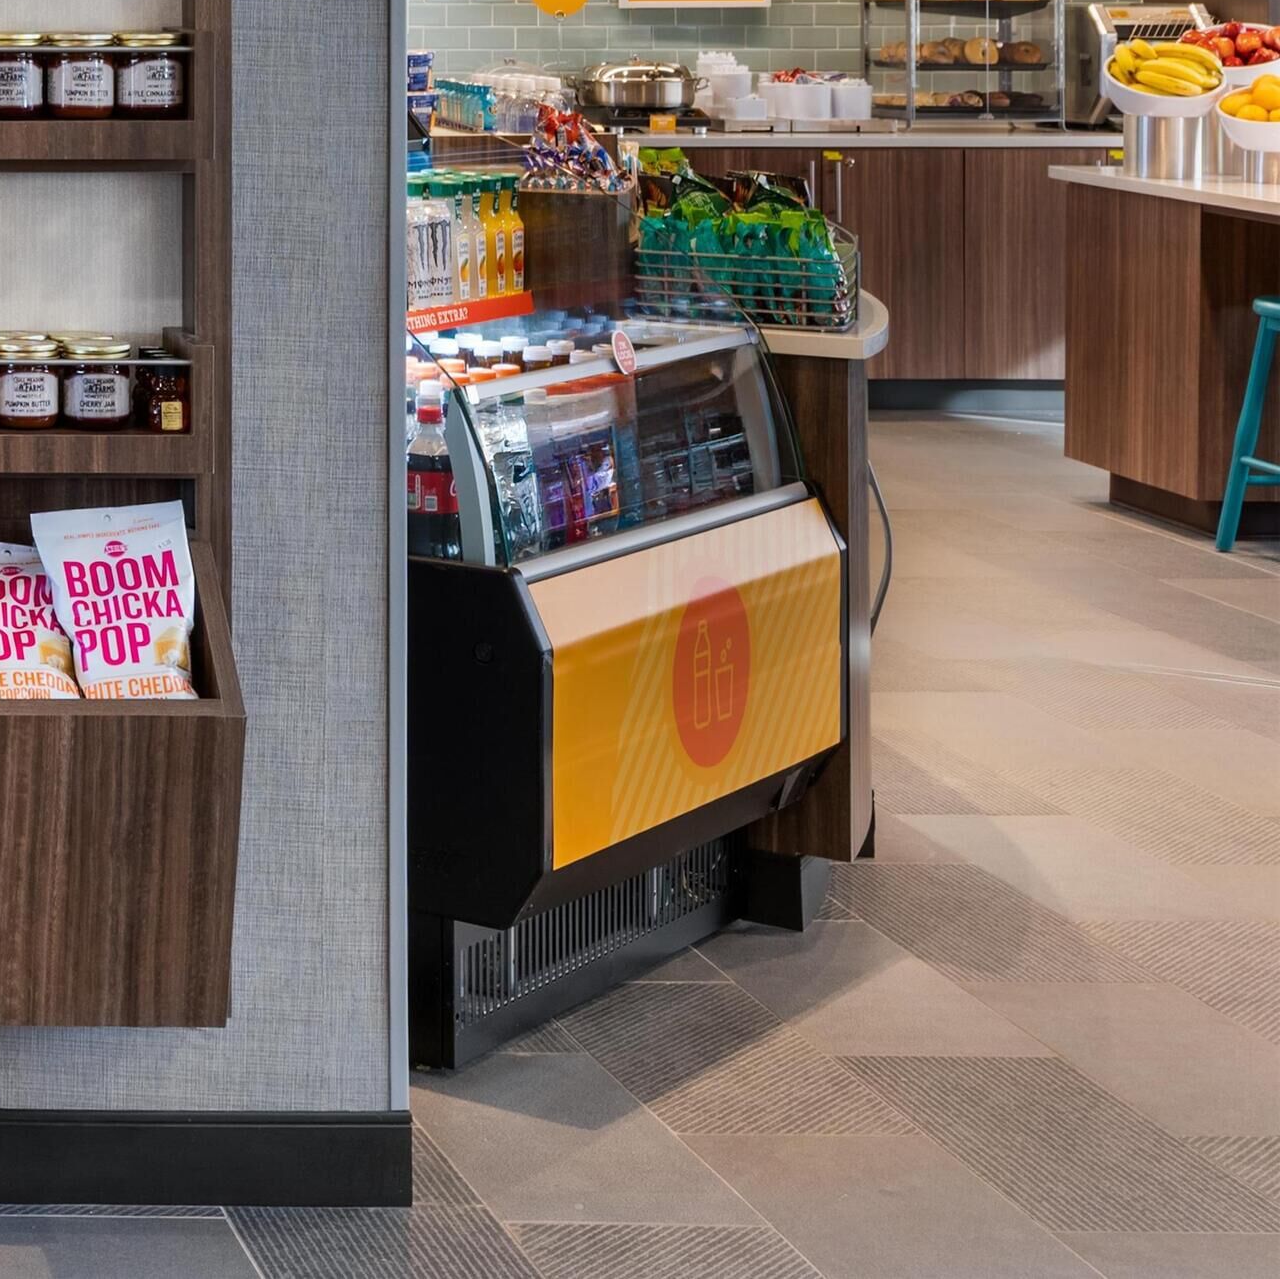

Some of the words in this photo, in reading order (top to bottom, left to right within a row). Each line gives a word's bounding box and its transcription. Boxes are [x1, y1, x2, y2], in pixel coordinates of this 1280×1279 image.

[439, 306, 469, 325] EXTRA?
[63, 550, 180, 598] BOOM
[71, 588, 185, 628] CHICKA
[74, 622, 152, 673] POP
